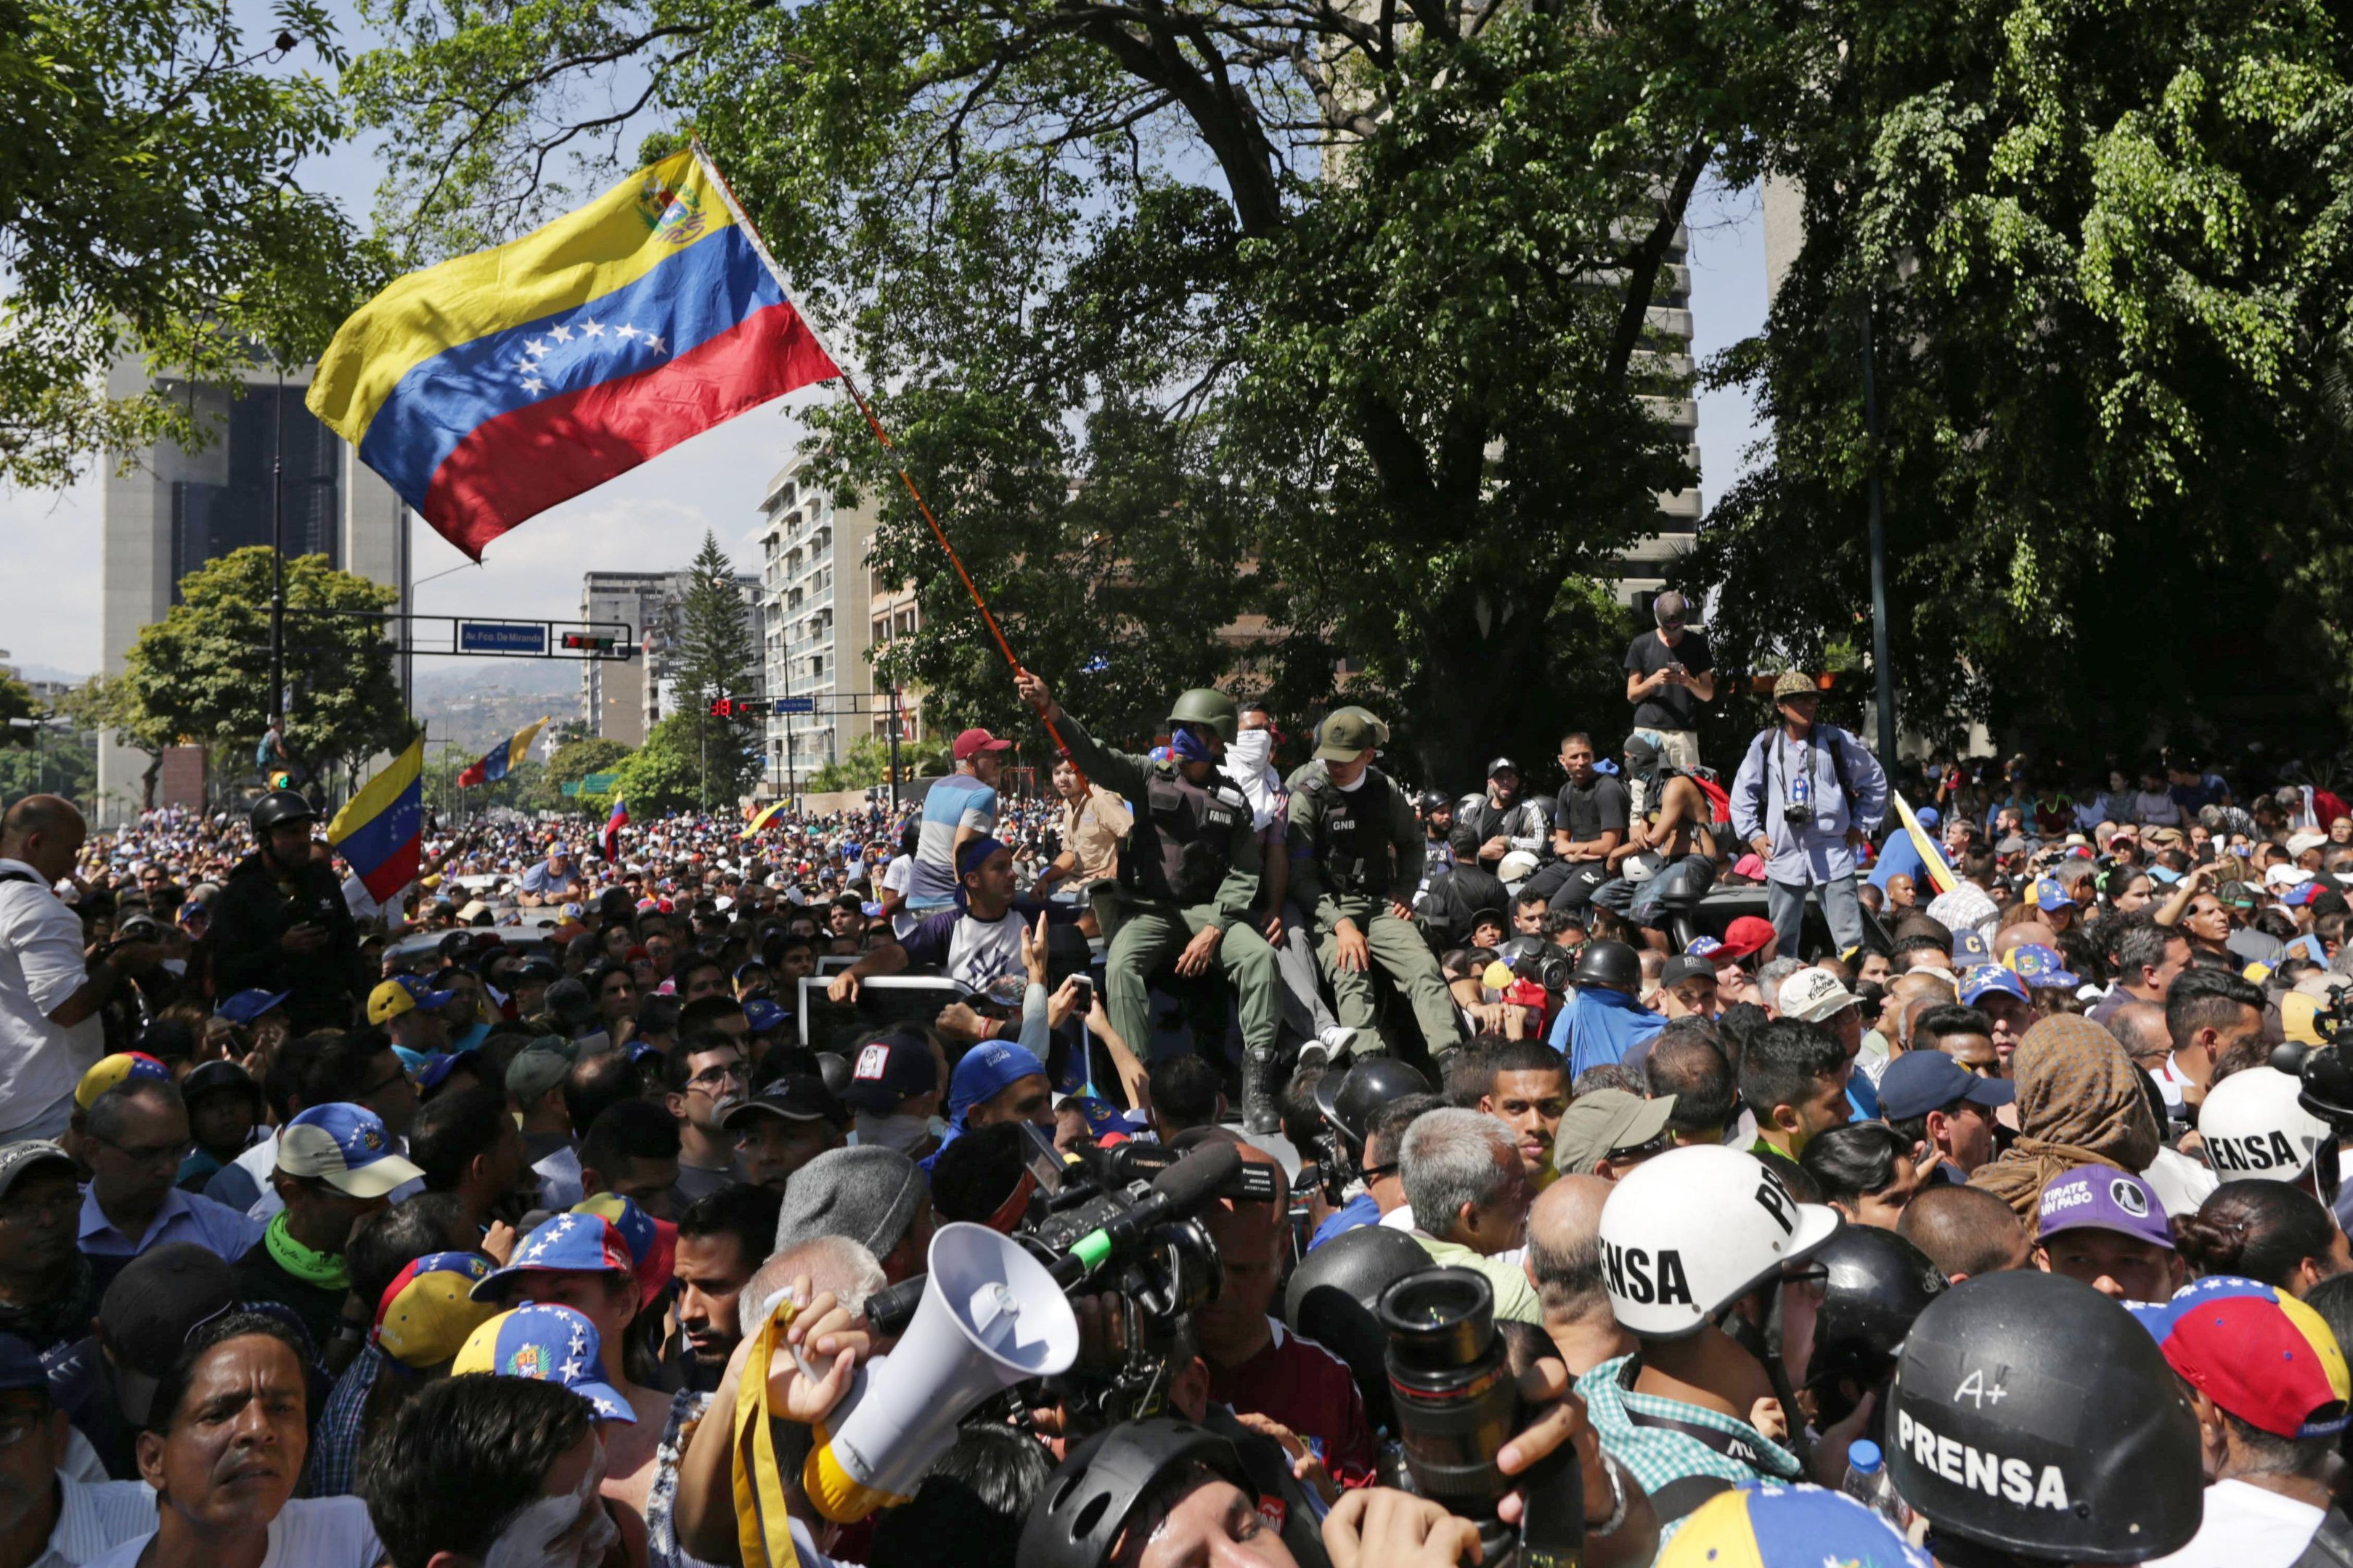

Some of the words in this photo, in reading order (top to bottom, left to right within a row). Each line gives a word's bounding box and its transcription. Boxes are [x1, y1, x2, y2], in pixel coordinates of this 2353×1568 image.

[465, 632, 477, 640] Av.
[497, 632, 508, 642] De
[509, 633, 542, 642] Miranda
[1209, 809, 1232, 825] FANB
[1333, 820, 1355, 831] GNB
[1965, 936, 1981, 953] C
[2044, 1180, 2088, 1203] TIRATE
[2041, 1201, 2056, 1217] UN
[2057, 1191, 2093, 1211] PASO
[1953, 1369, 2008, 1410] A+
[1899, 1408, 2069, 1511] PRENSA
